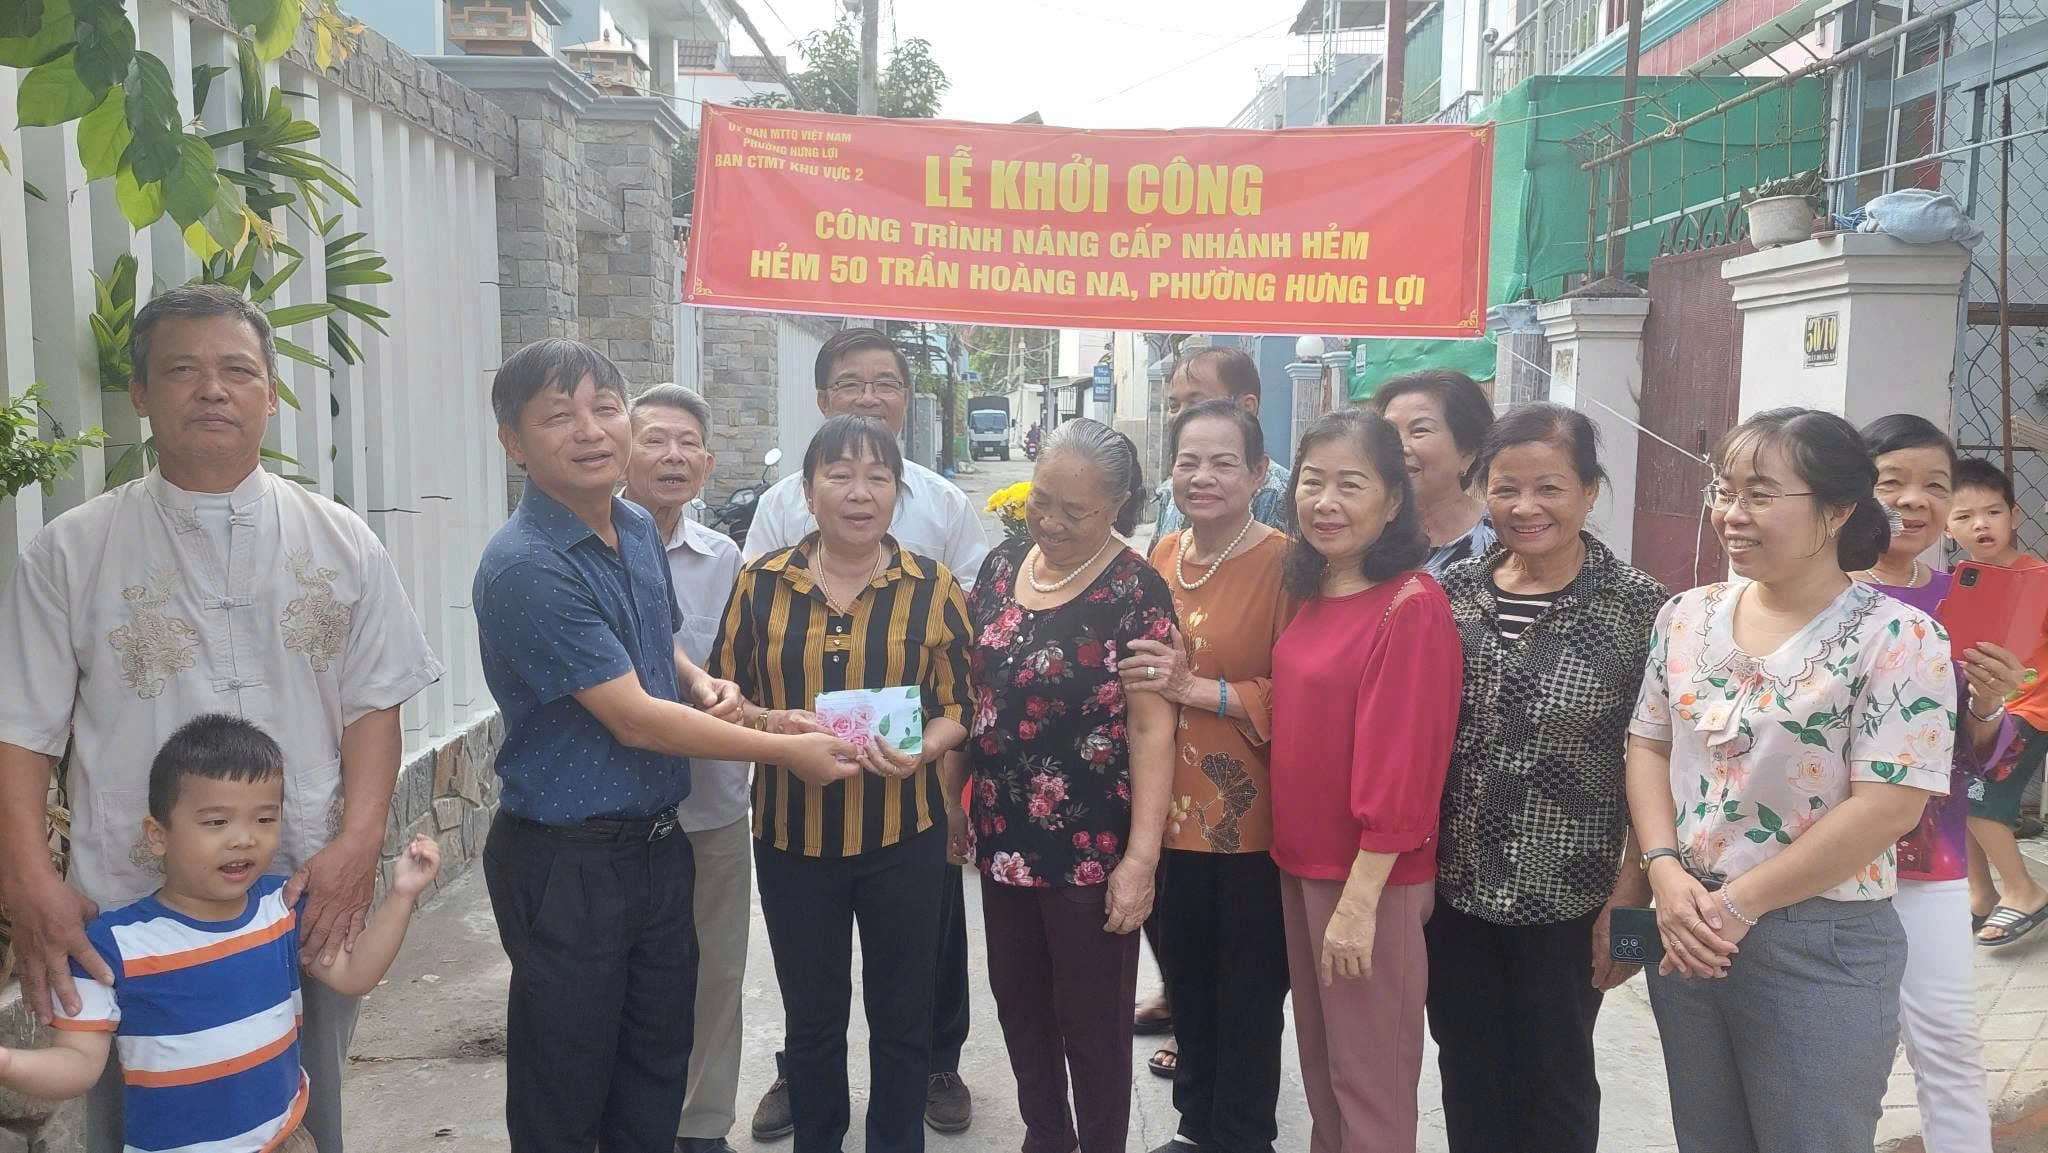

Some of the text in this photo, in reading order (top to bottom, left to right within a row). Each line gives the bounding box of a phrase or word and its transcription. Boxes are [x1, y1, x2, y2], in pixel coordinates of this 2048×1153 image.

[801, 128, 824, 143] VIỆT
[826, 132, 853, 143] NAM
[715, 154, 865, 182] BAN CTMT KHU VỰC 2
[924, 142, 1265, 217] LỄ KHỞI CÔNG
[815, 208, 1370, 262] CÔNG TRÌNH NÂNG CẤP NHÁNH HẺM
[749, 243, 1426, 312] HẺM 50 TRẦN HOÀNG NA, PHƯỜNG HƯNG LỢI
[1806, 318, 1836, 352] 50/10
